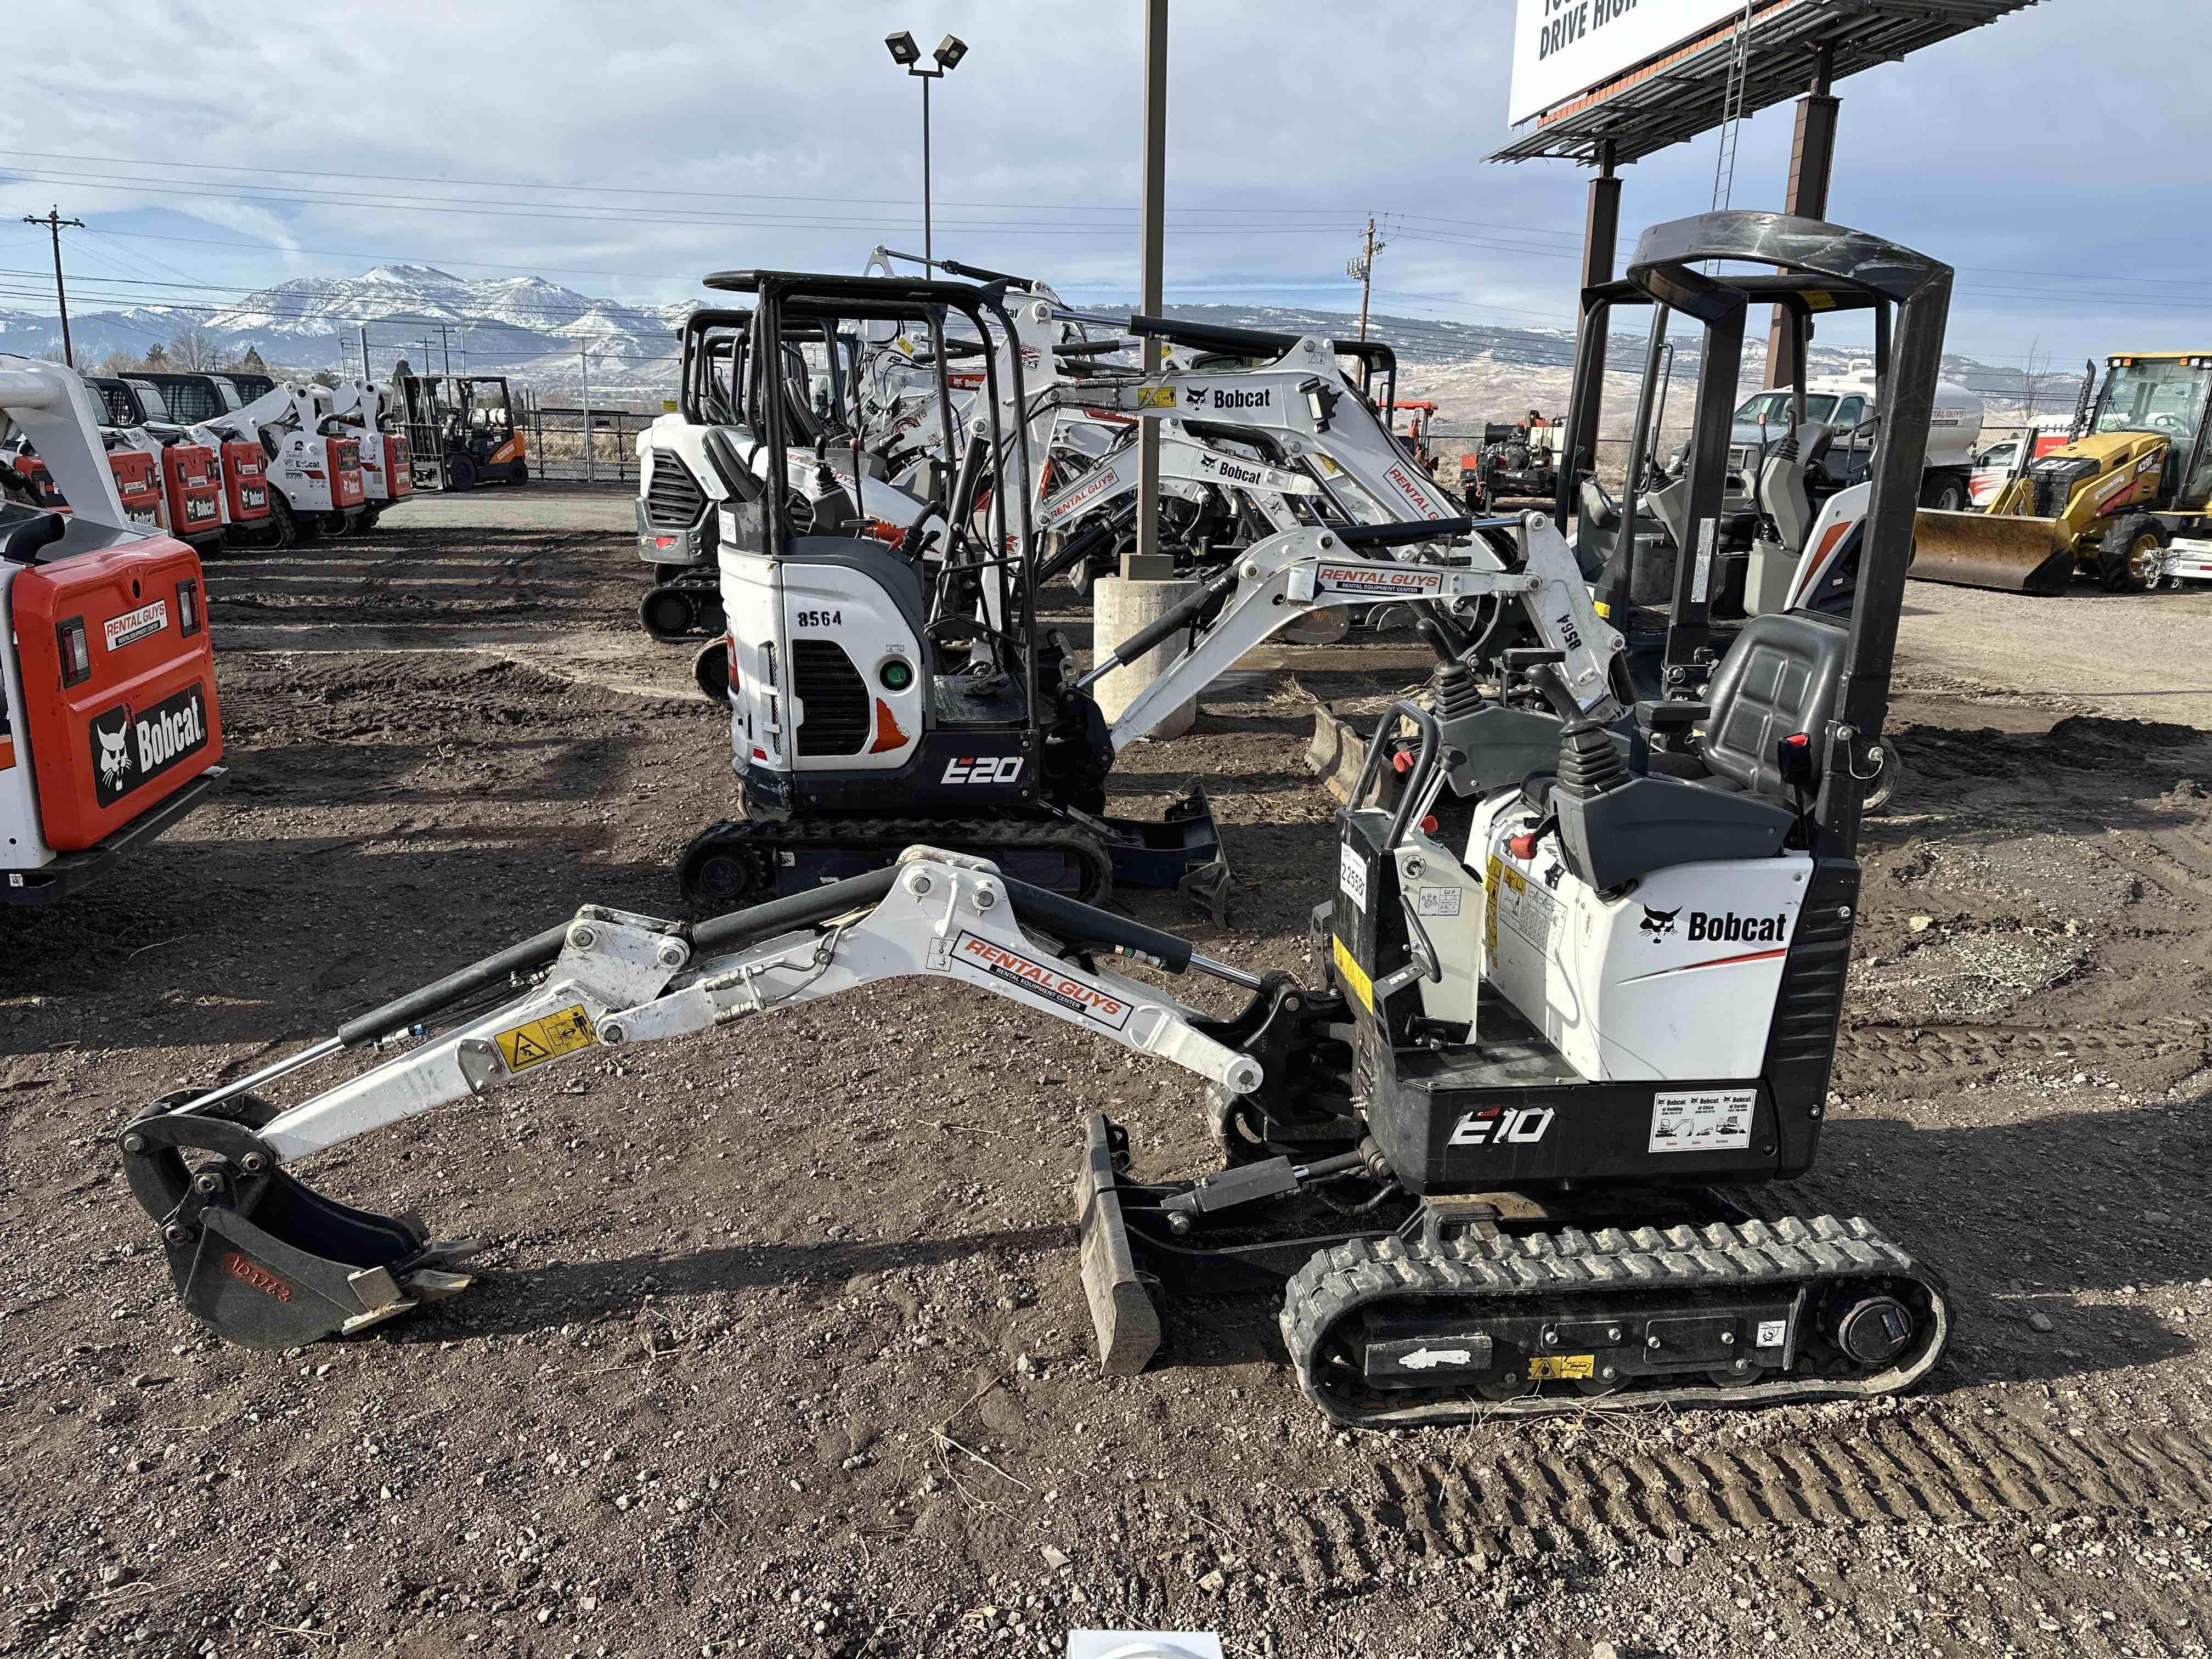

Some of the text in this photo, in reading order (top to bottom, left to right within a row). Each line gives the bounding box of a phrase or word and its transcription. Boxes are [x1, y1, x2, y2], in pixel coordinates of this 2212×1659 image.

[1539, 1, 1588, 61] DRIVE
[1214, 389, 1271, 408] Bobcat
[1219, 461, 1261, 485] Bobcat
[2036, 460, 2081, 471] CAT
[2138, 454, 2154, 472] 420F
[1053, 473, 1115, 516] RENTAL GUYS
[1389, 469, 1429, 513] RENTAL
[196, 499, 216, 517] Bobcat
[1321, 569, 1439, 586] RENTAL GUYS
[107, 603, 165, 637] RENTAL GUYS
[798, 611, 842, 627] 8564
[1556, 614, 1582, 651] 8564
[136, 696, 201, 773] Bobcat
[940, 757, 1024, 784] E20
[1688, 912, 1787, 941] Bobcat
[964, 939, 1122, 1015] RENTAL GUYS
[996, 967, 1081, 1008] RENTAL EQUIPMENT CENTER
[1448, 1106, 1555, 1145] E10
